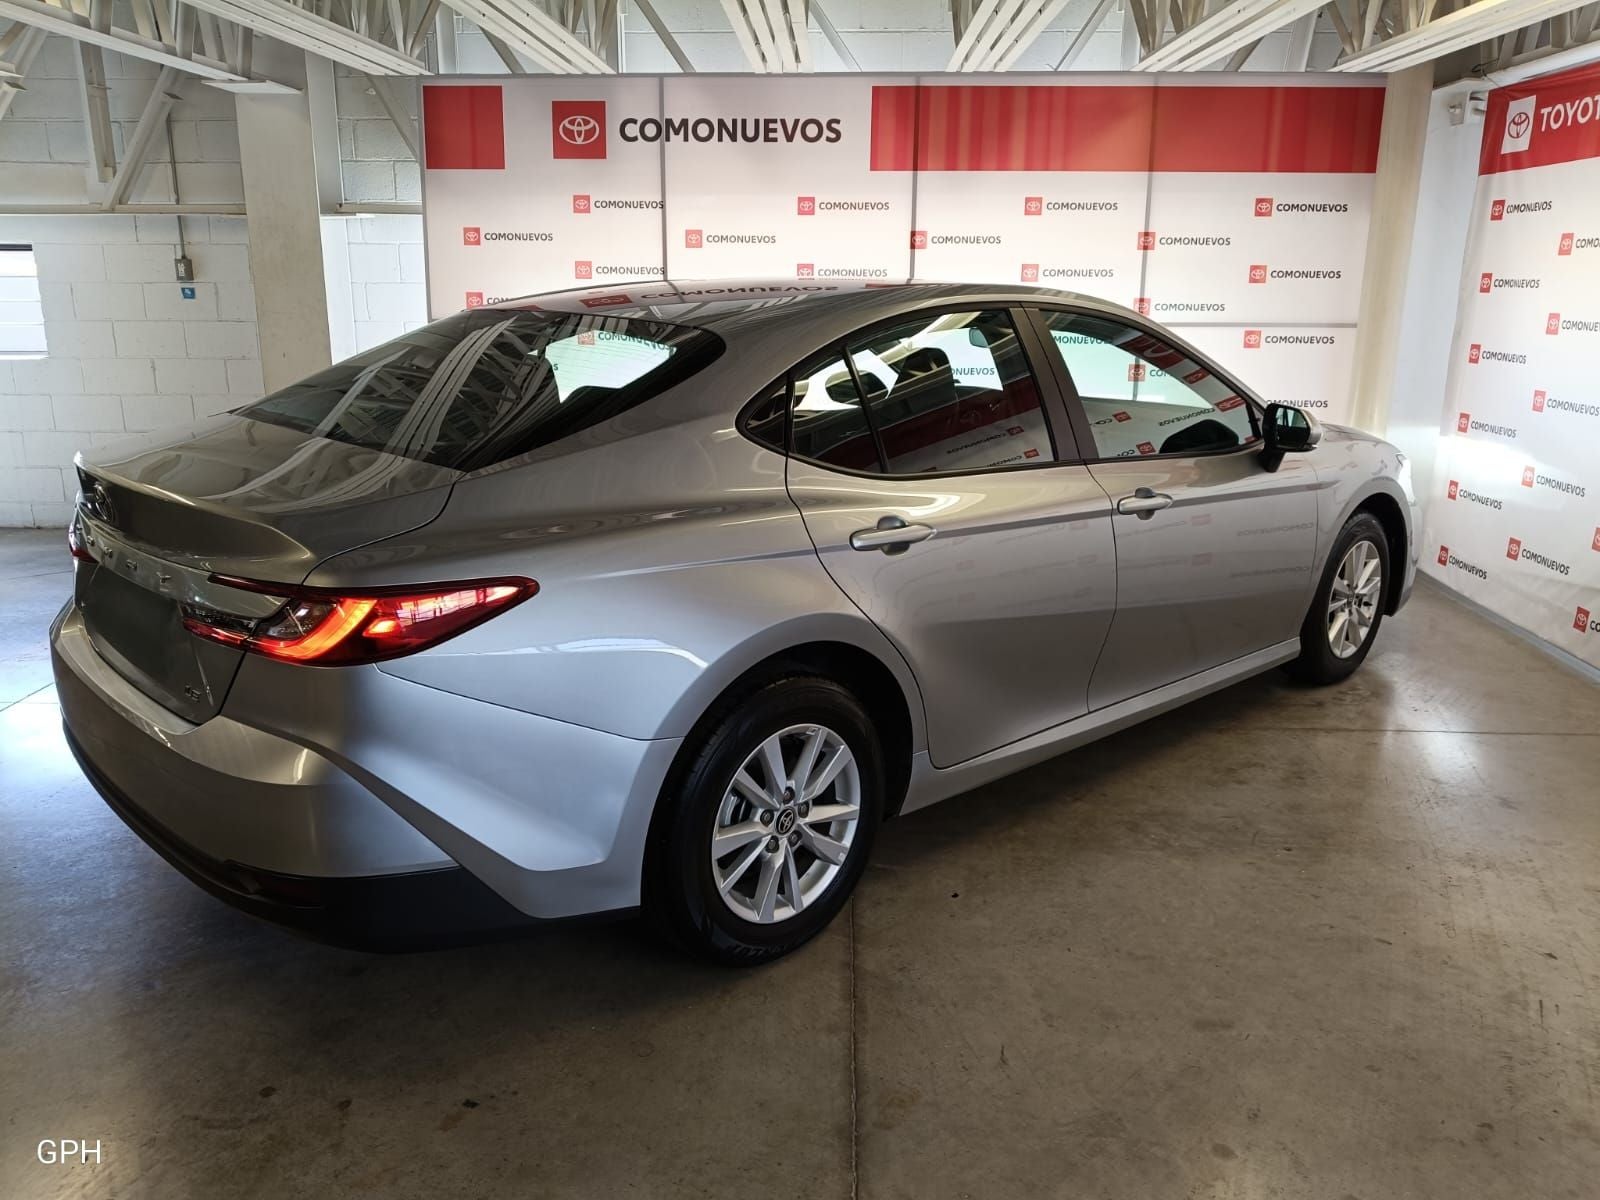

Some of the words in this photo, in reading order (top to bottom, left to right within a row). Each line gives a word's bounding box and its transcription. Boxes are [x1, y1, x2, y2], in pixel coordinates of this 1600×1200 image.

[618, 117, 842, 144] COMONUEVOS
[594, 200, 664, 210] COMONUEVOS
[818, 201, 890, 211] COMONUEVOS
[1046, 202, 1119, 211] COMONUEVOS
[1276, 203, 1349, 213] COMONUEVOS
[1506, 200, 1552, 214] COMONUEVOS
[484, 232, 554, 242] COMONUEVOS
[706, 234, 777, 244] COMONUEVOS
[931, 235, 1002, 245] COMONUEVOS
[1159, 237, 1231, 247] COMONUEVOS
[595, 266, 665, 276] COMONUEVOS
[817, 268, 888, 278] COMONUEVOS
[1042, 268, 1114, 278] COMONUEVOS
[1270, 270, 1342, 280] COMONUEVOS
[1493, 278, 1541, 289] COMONUEVOS
[1154, 303, 1226, 313] COMONUEVOS
[1561, 319, 1600, 332] COMONUE
[1265, 335, 1336, 345] COMONUEVOS
[1481, 350, 1527, 365] COMONUEVOS
[1546, 398, 1600, 417] COMONUEVOS
[1470, 420, 1517, 439] COMONUEVOS
[1535, 474, 1586, 498] COMONUEVOS
[1458, 488, 1503, 511] COMONUEVOS
[1521, 548, 1571, 576] COMONUEVOS
[1448, 555, 1488, 580] COMONUEVOS
